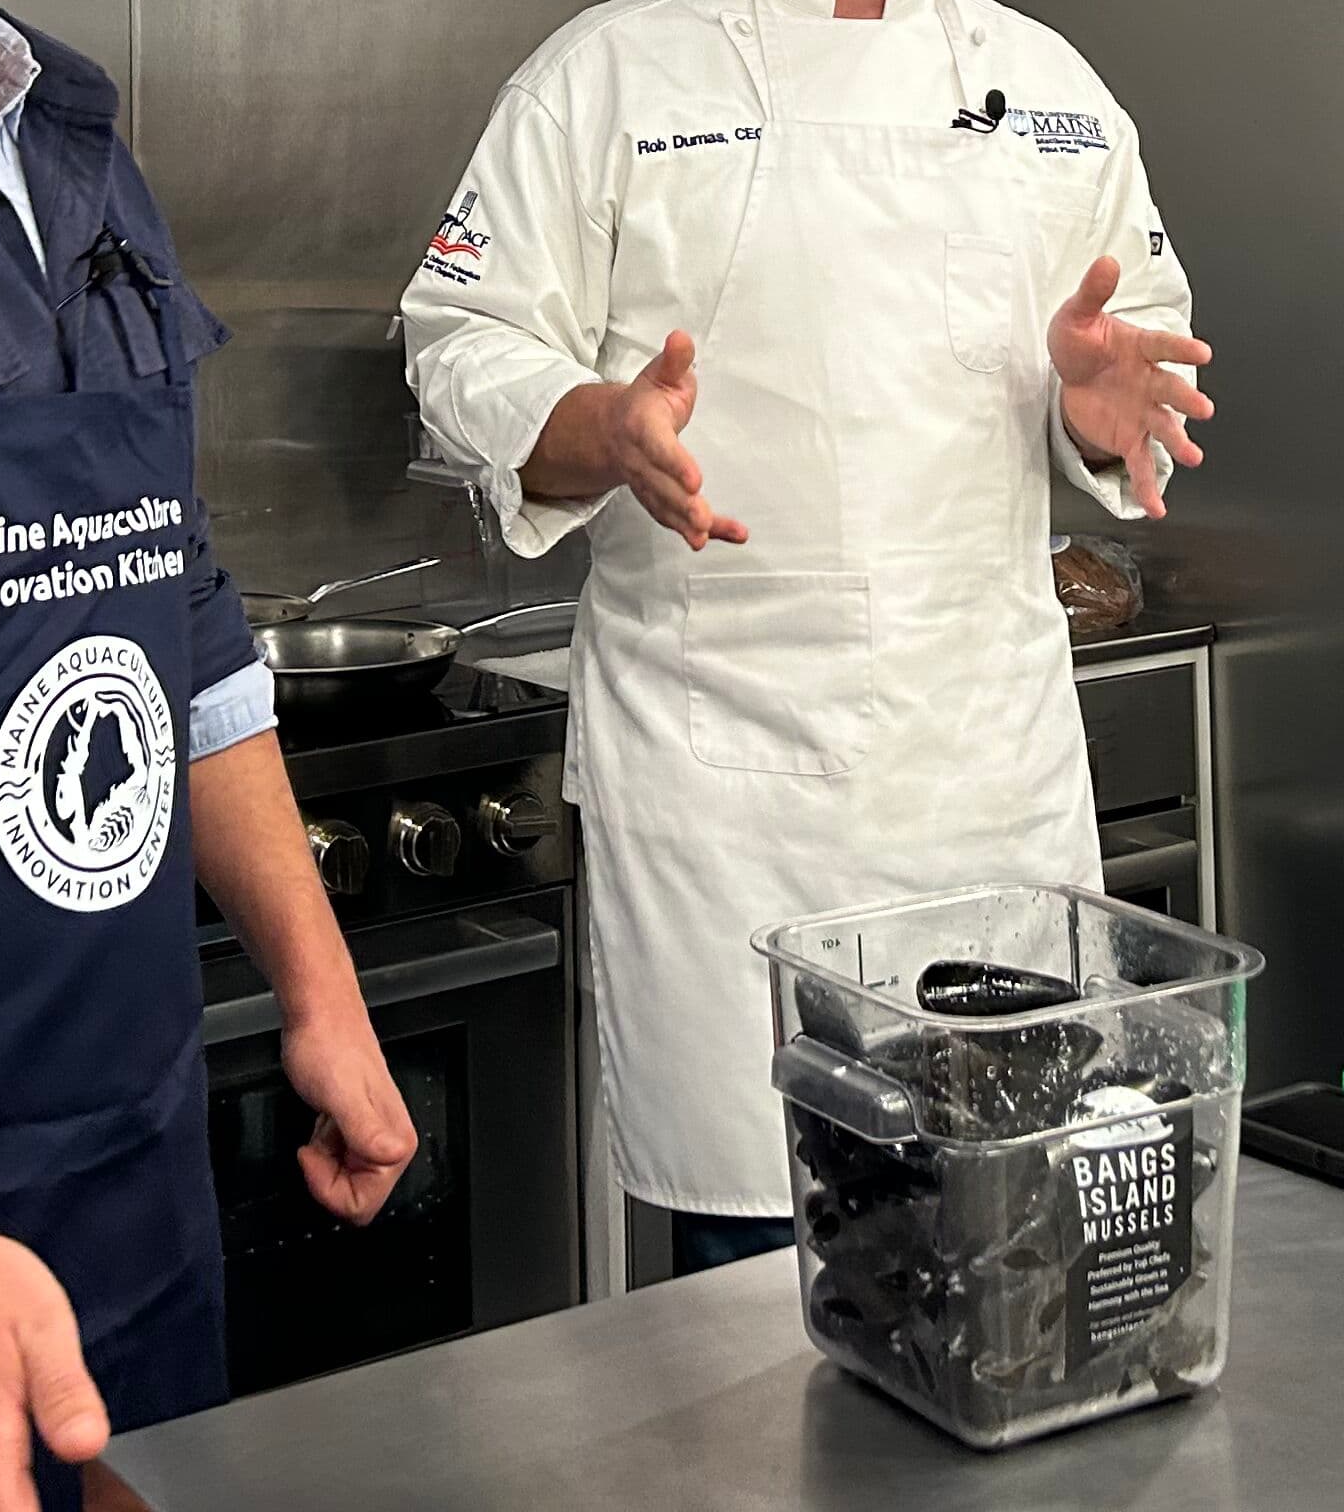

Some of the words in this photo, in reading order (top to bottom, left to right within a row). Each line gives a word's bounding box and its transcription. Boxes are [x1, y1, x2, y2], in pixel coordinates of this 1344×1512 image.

[637, 138, 667, 155] Rob
[673, 132, 729, 150] Dumas,
[1032, 116, 1104, 138] MAINE
[462, 229, 491, 249] ACF
[0, 678, 51, 769] MAINE
[55, 645, 169, 737] AQUACULTURE
[2, 813, 132, 901] INNOVATION
[138, 779, 172, 878] CENTER
[1072, 1142, 1176, 1189] BANGS
[1078, 1174, 1176, 1219] ISLAND
[1083, 1203, 1174, 1245] MUSSELS
[1148, 1251, 1171, 1266] Chefs
